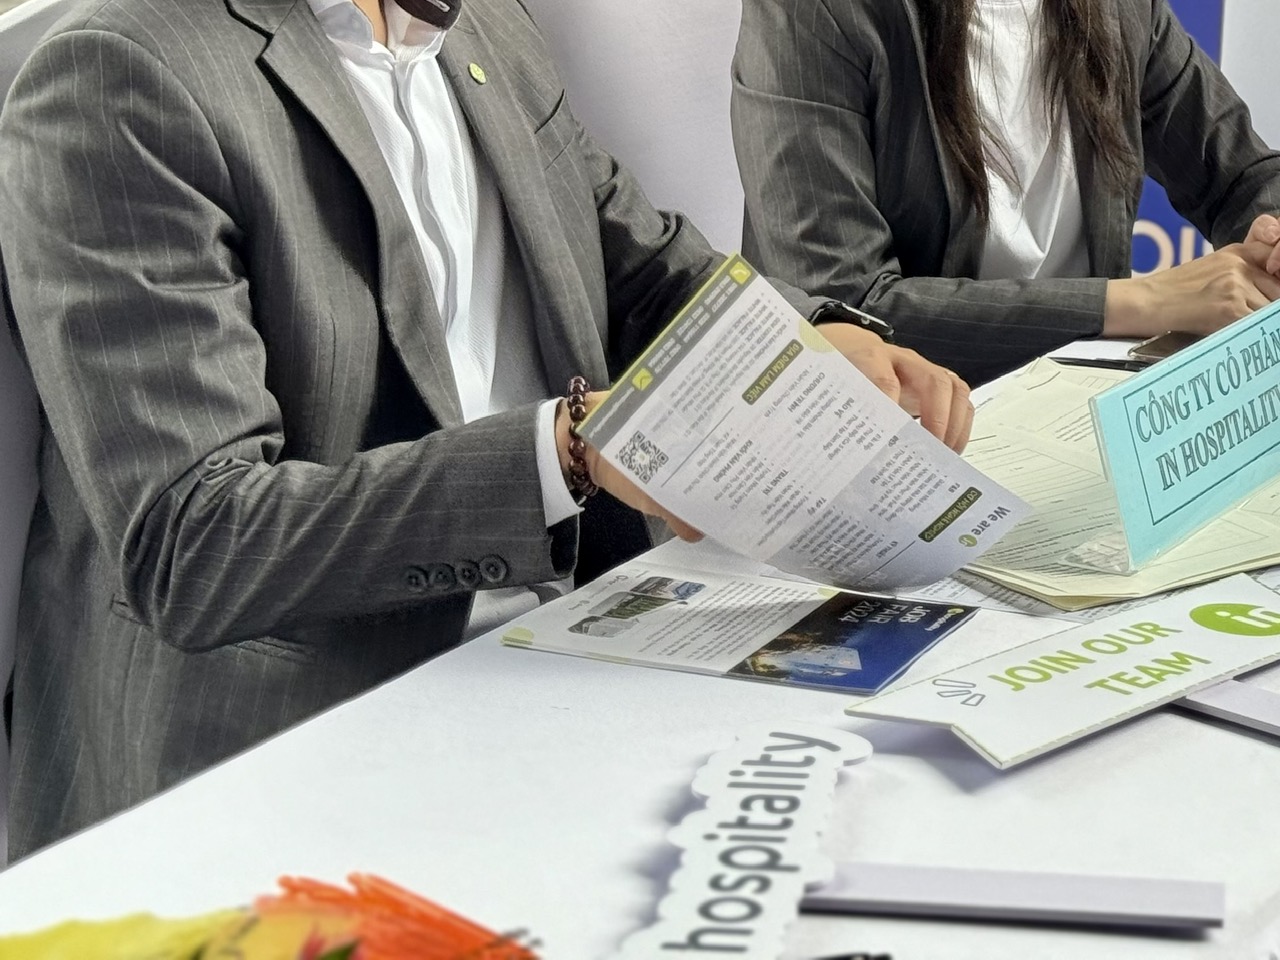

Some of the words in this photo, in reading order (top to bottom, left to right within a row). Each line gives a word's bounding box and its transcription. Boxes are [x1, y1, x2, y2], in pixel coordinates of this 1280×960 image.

[1135, 390, 1190, 442] CÔNG
[1186, 374, 1214, 412] TY
[1155, 451, 1181, 491] IN
[970, 519, 990, 535] are
[987, 503, 1011, 520] We
[867, 602, 907, 624] FAIR
[897, 604, 930, 624] JOB
[988, 650, 1096, 692] JOIN
[1082, 622, 1183, 655] OUR
[1084, 651, 1211, 695] TEAM
[660, 732, 841, 953] hospitality
